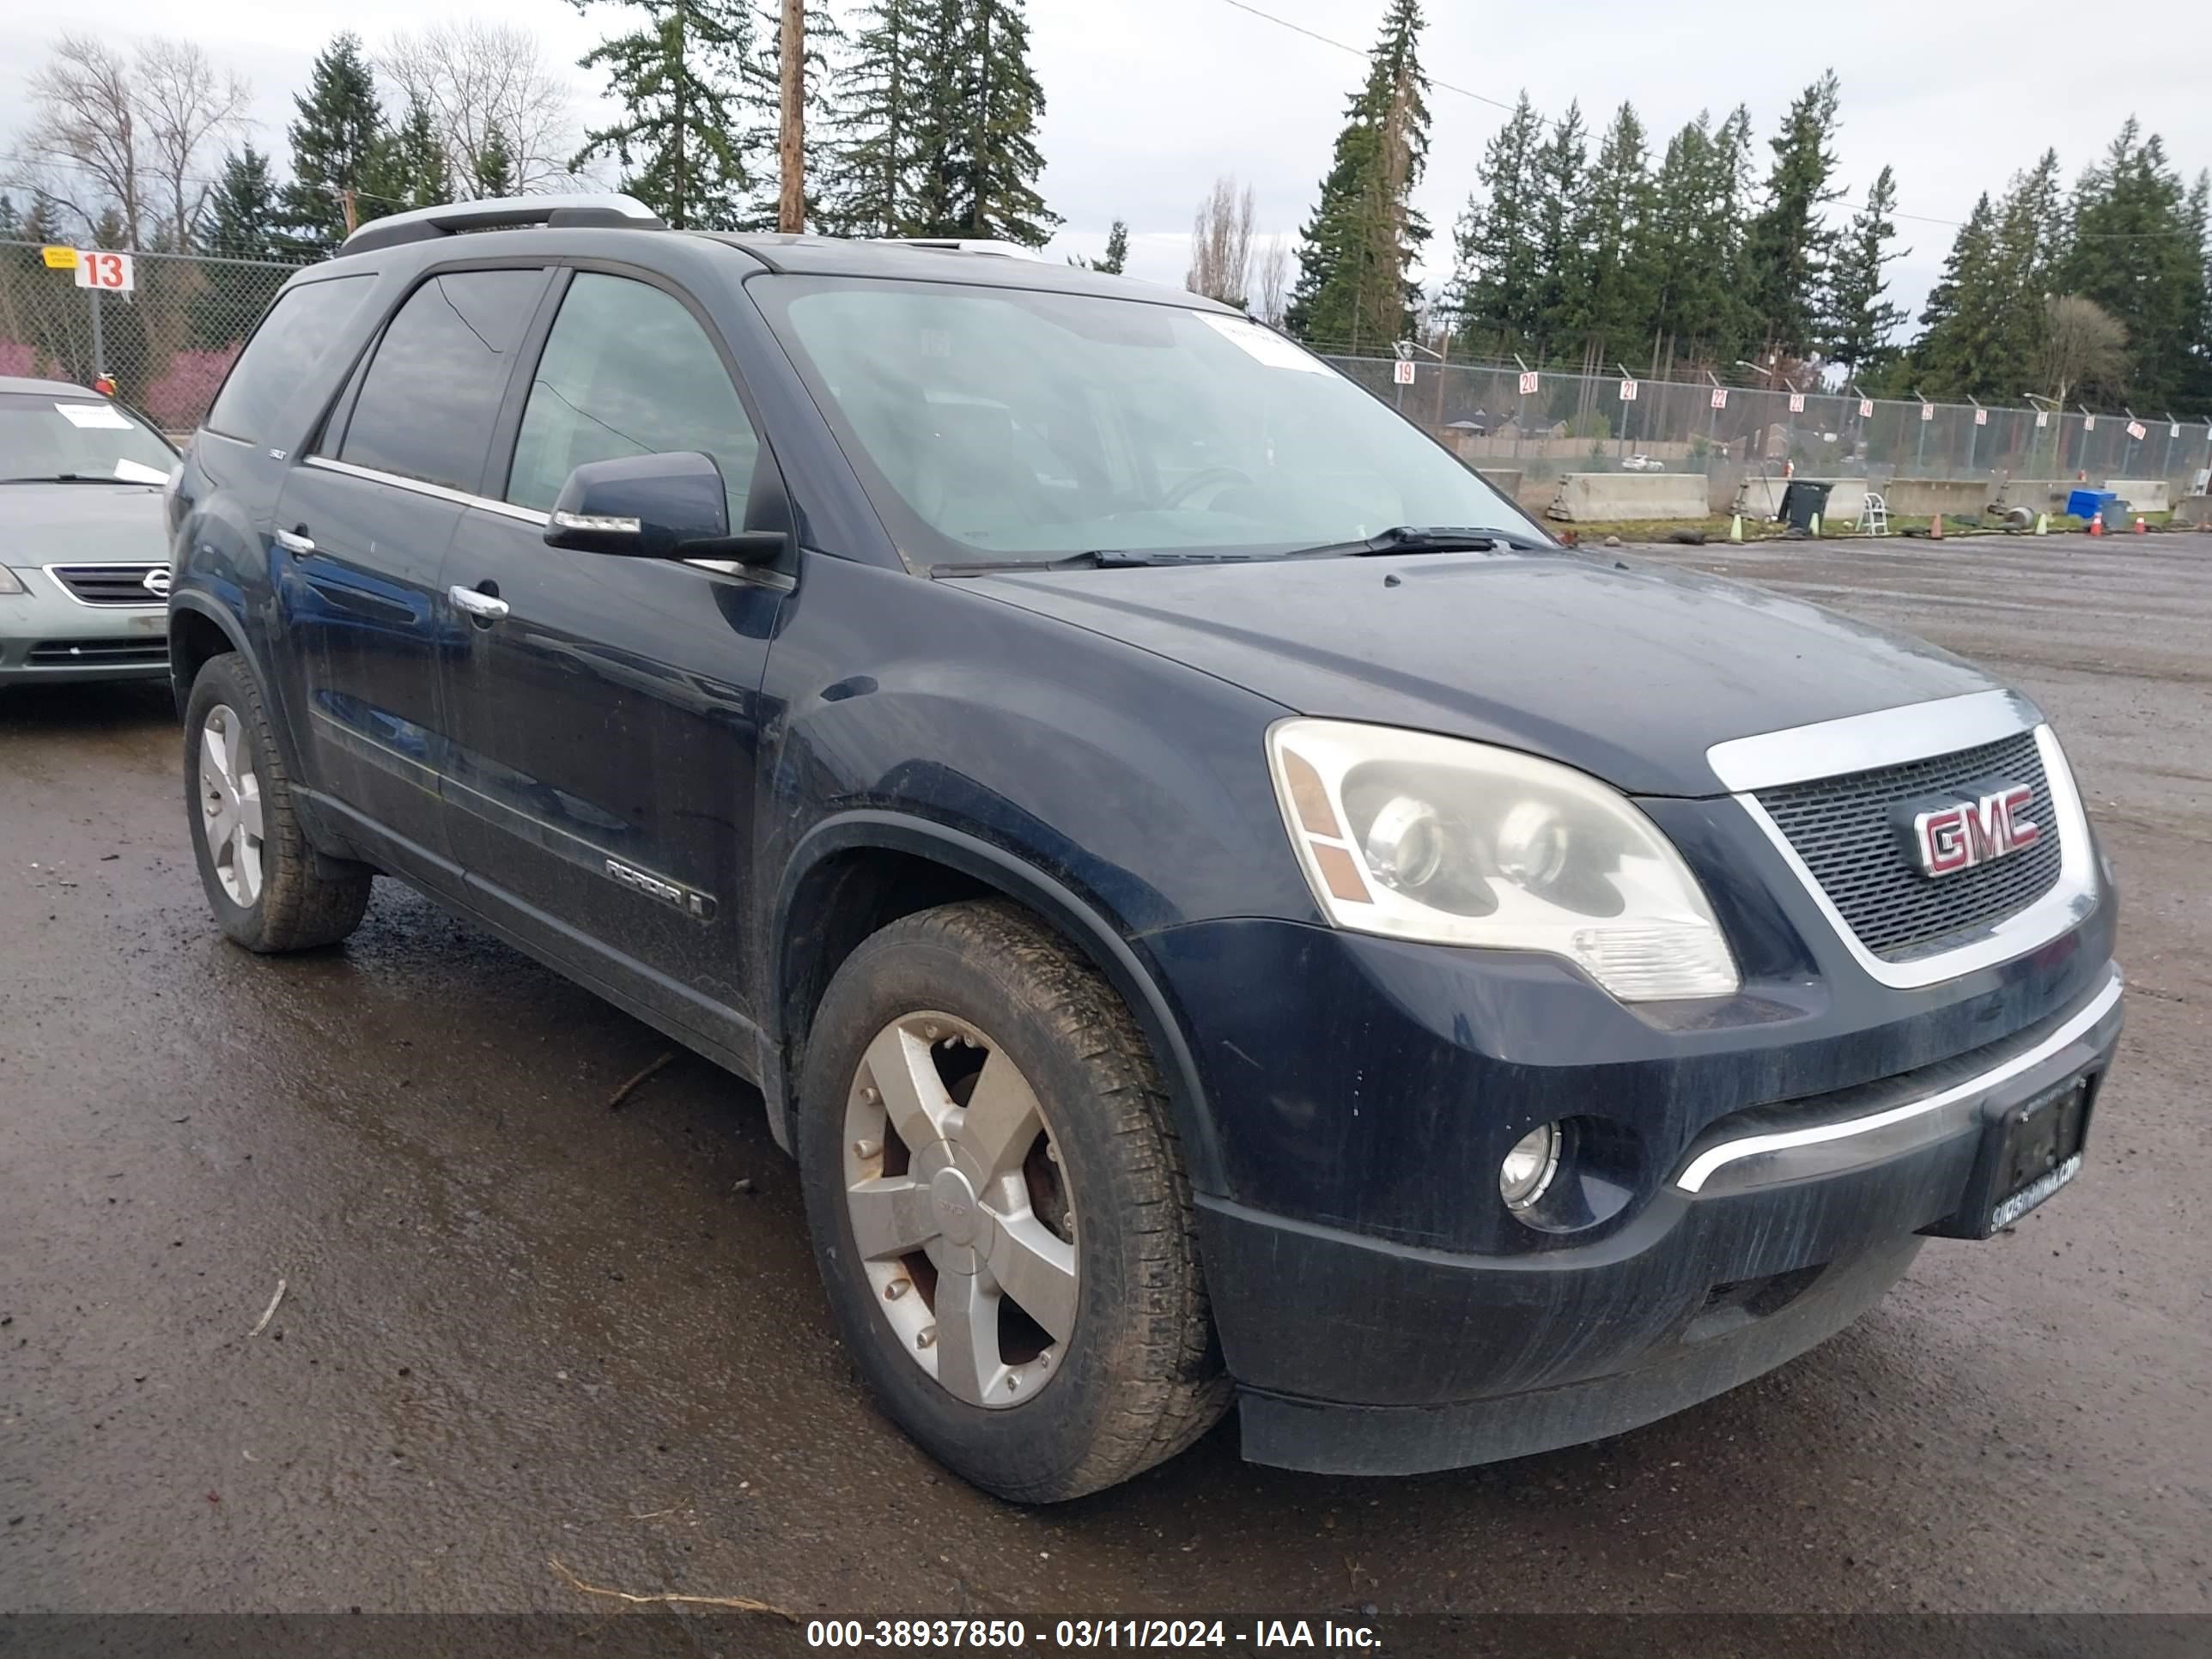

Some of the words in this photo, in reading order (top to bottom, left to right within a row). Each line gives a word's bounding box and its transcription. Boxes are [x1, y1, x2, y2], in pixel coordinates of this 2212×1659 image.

[84, 253, 123, 287] 13
[1399, 362, 1412, 382] 19
[1522, 374, 1536, 392] 20
[1624, 381, 1634, 398] 21
[1714, 389, 1725, 406] 22
[1915, 783, 2039, 878] GMC
[605, 859, 682, 904] ACADIA
